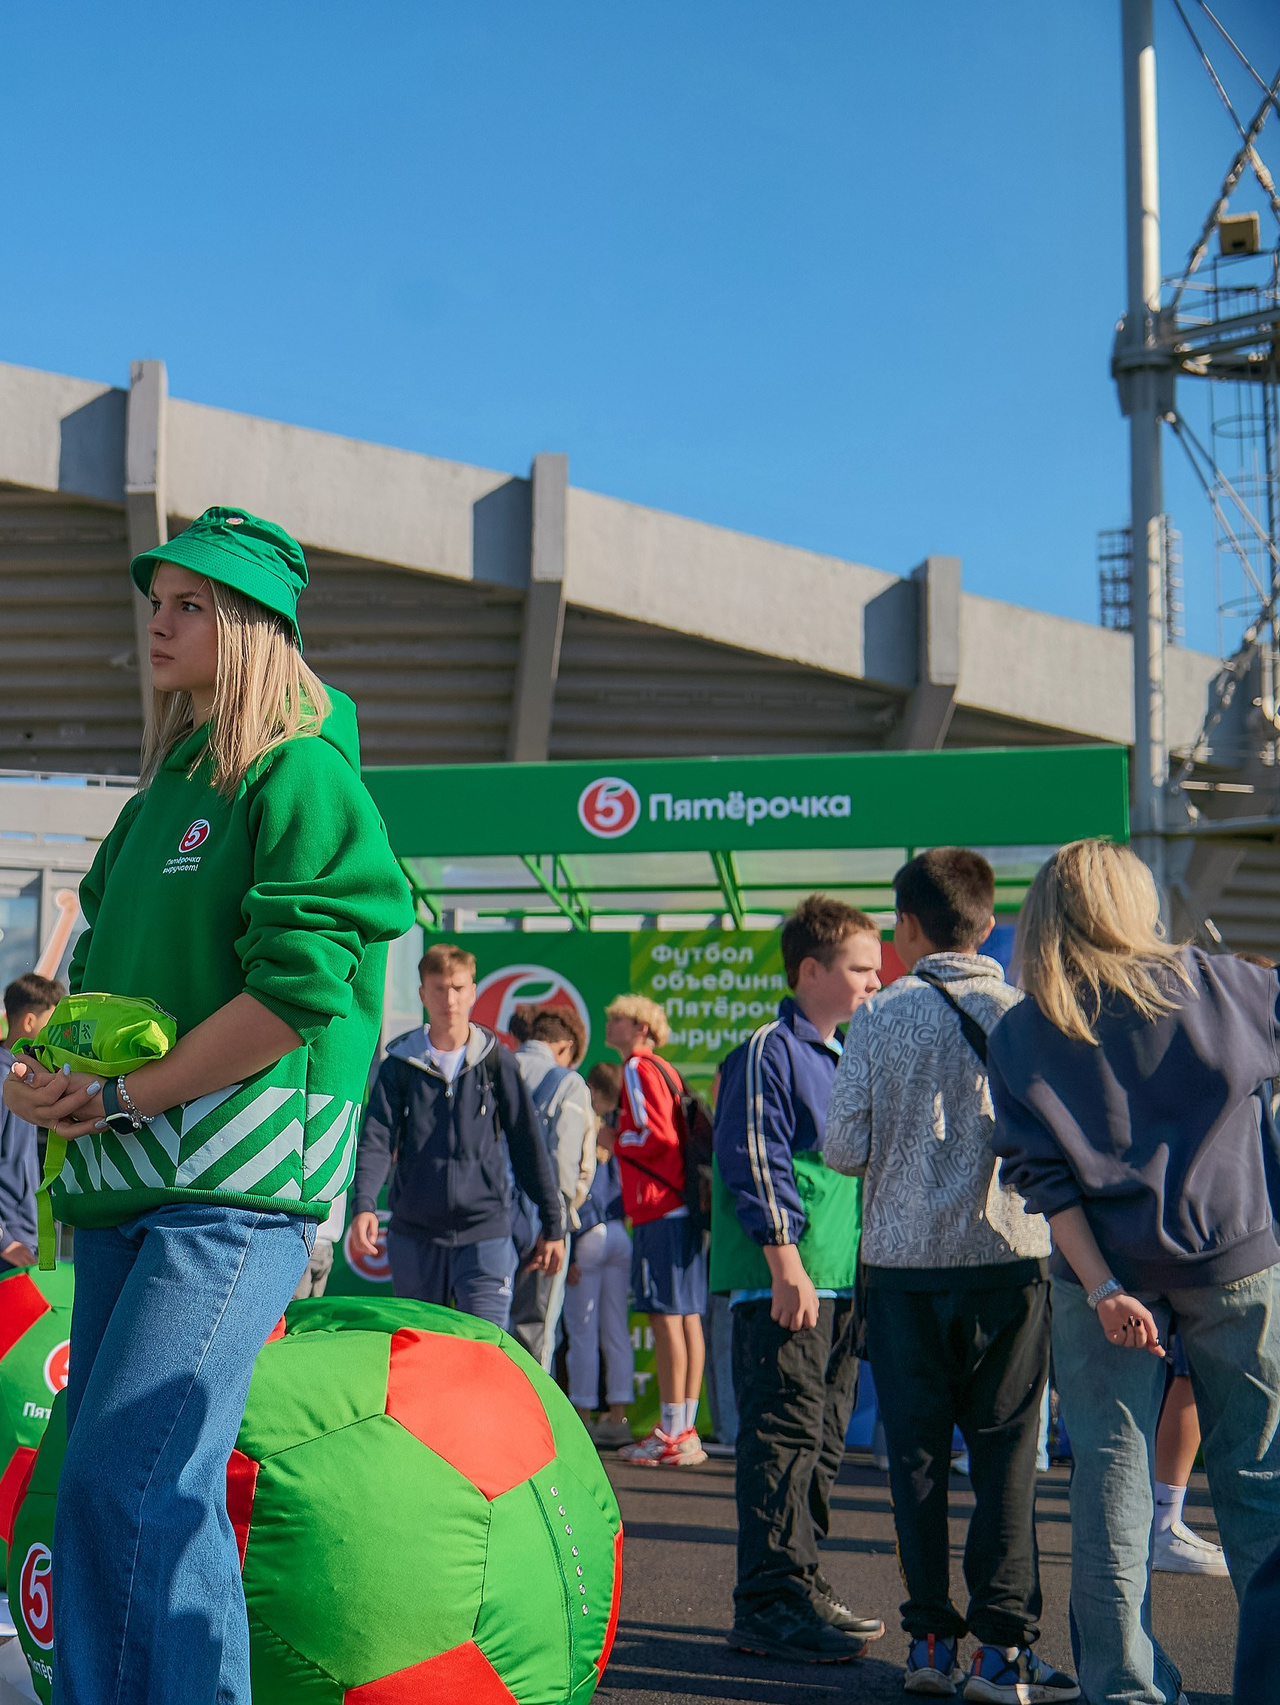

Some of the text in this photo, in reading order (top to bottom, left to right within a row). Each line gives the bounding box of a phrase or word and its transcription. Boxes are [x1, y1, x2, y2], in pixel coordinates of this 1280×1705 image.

[649, 791, 851, 826] Пятёрочка
[651, 942, 754, 968] Футбол
[663, 996, 780, 1022] Пятёроч
